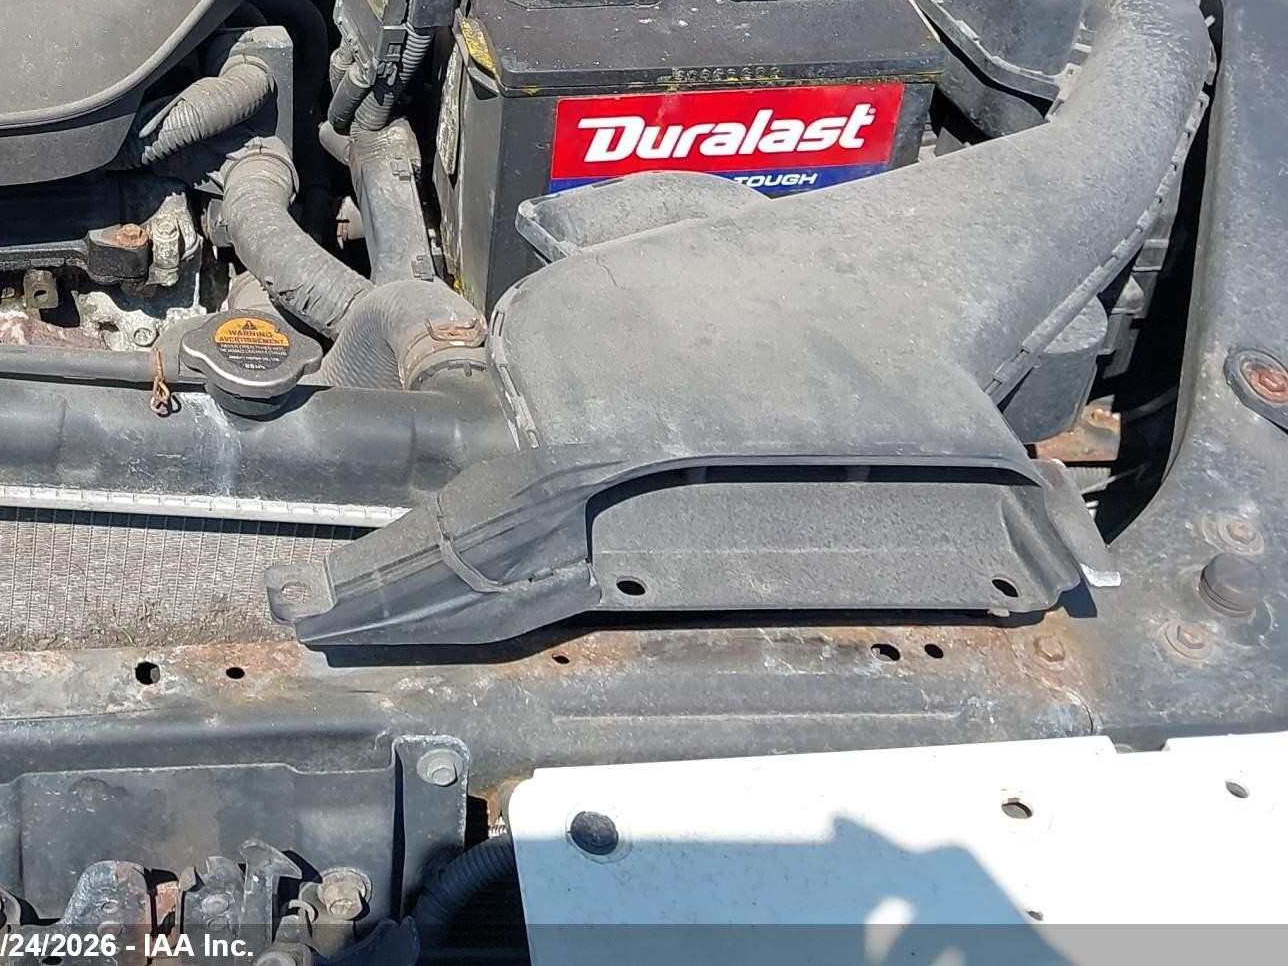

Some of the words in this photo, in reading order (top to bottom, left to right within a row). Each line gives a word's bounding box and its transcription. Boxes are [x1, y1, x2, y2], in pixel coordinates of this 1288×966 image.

[578, 103, 877, 163] Duralast
[733, 173, 818, 187] TOUGH
[228, 330, 273, 338] WARNING
